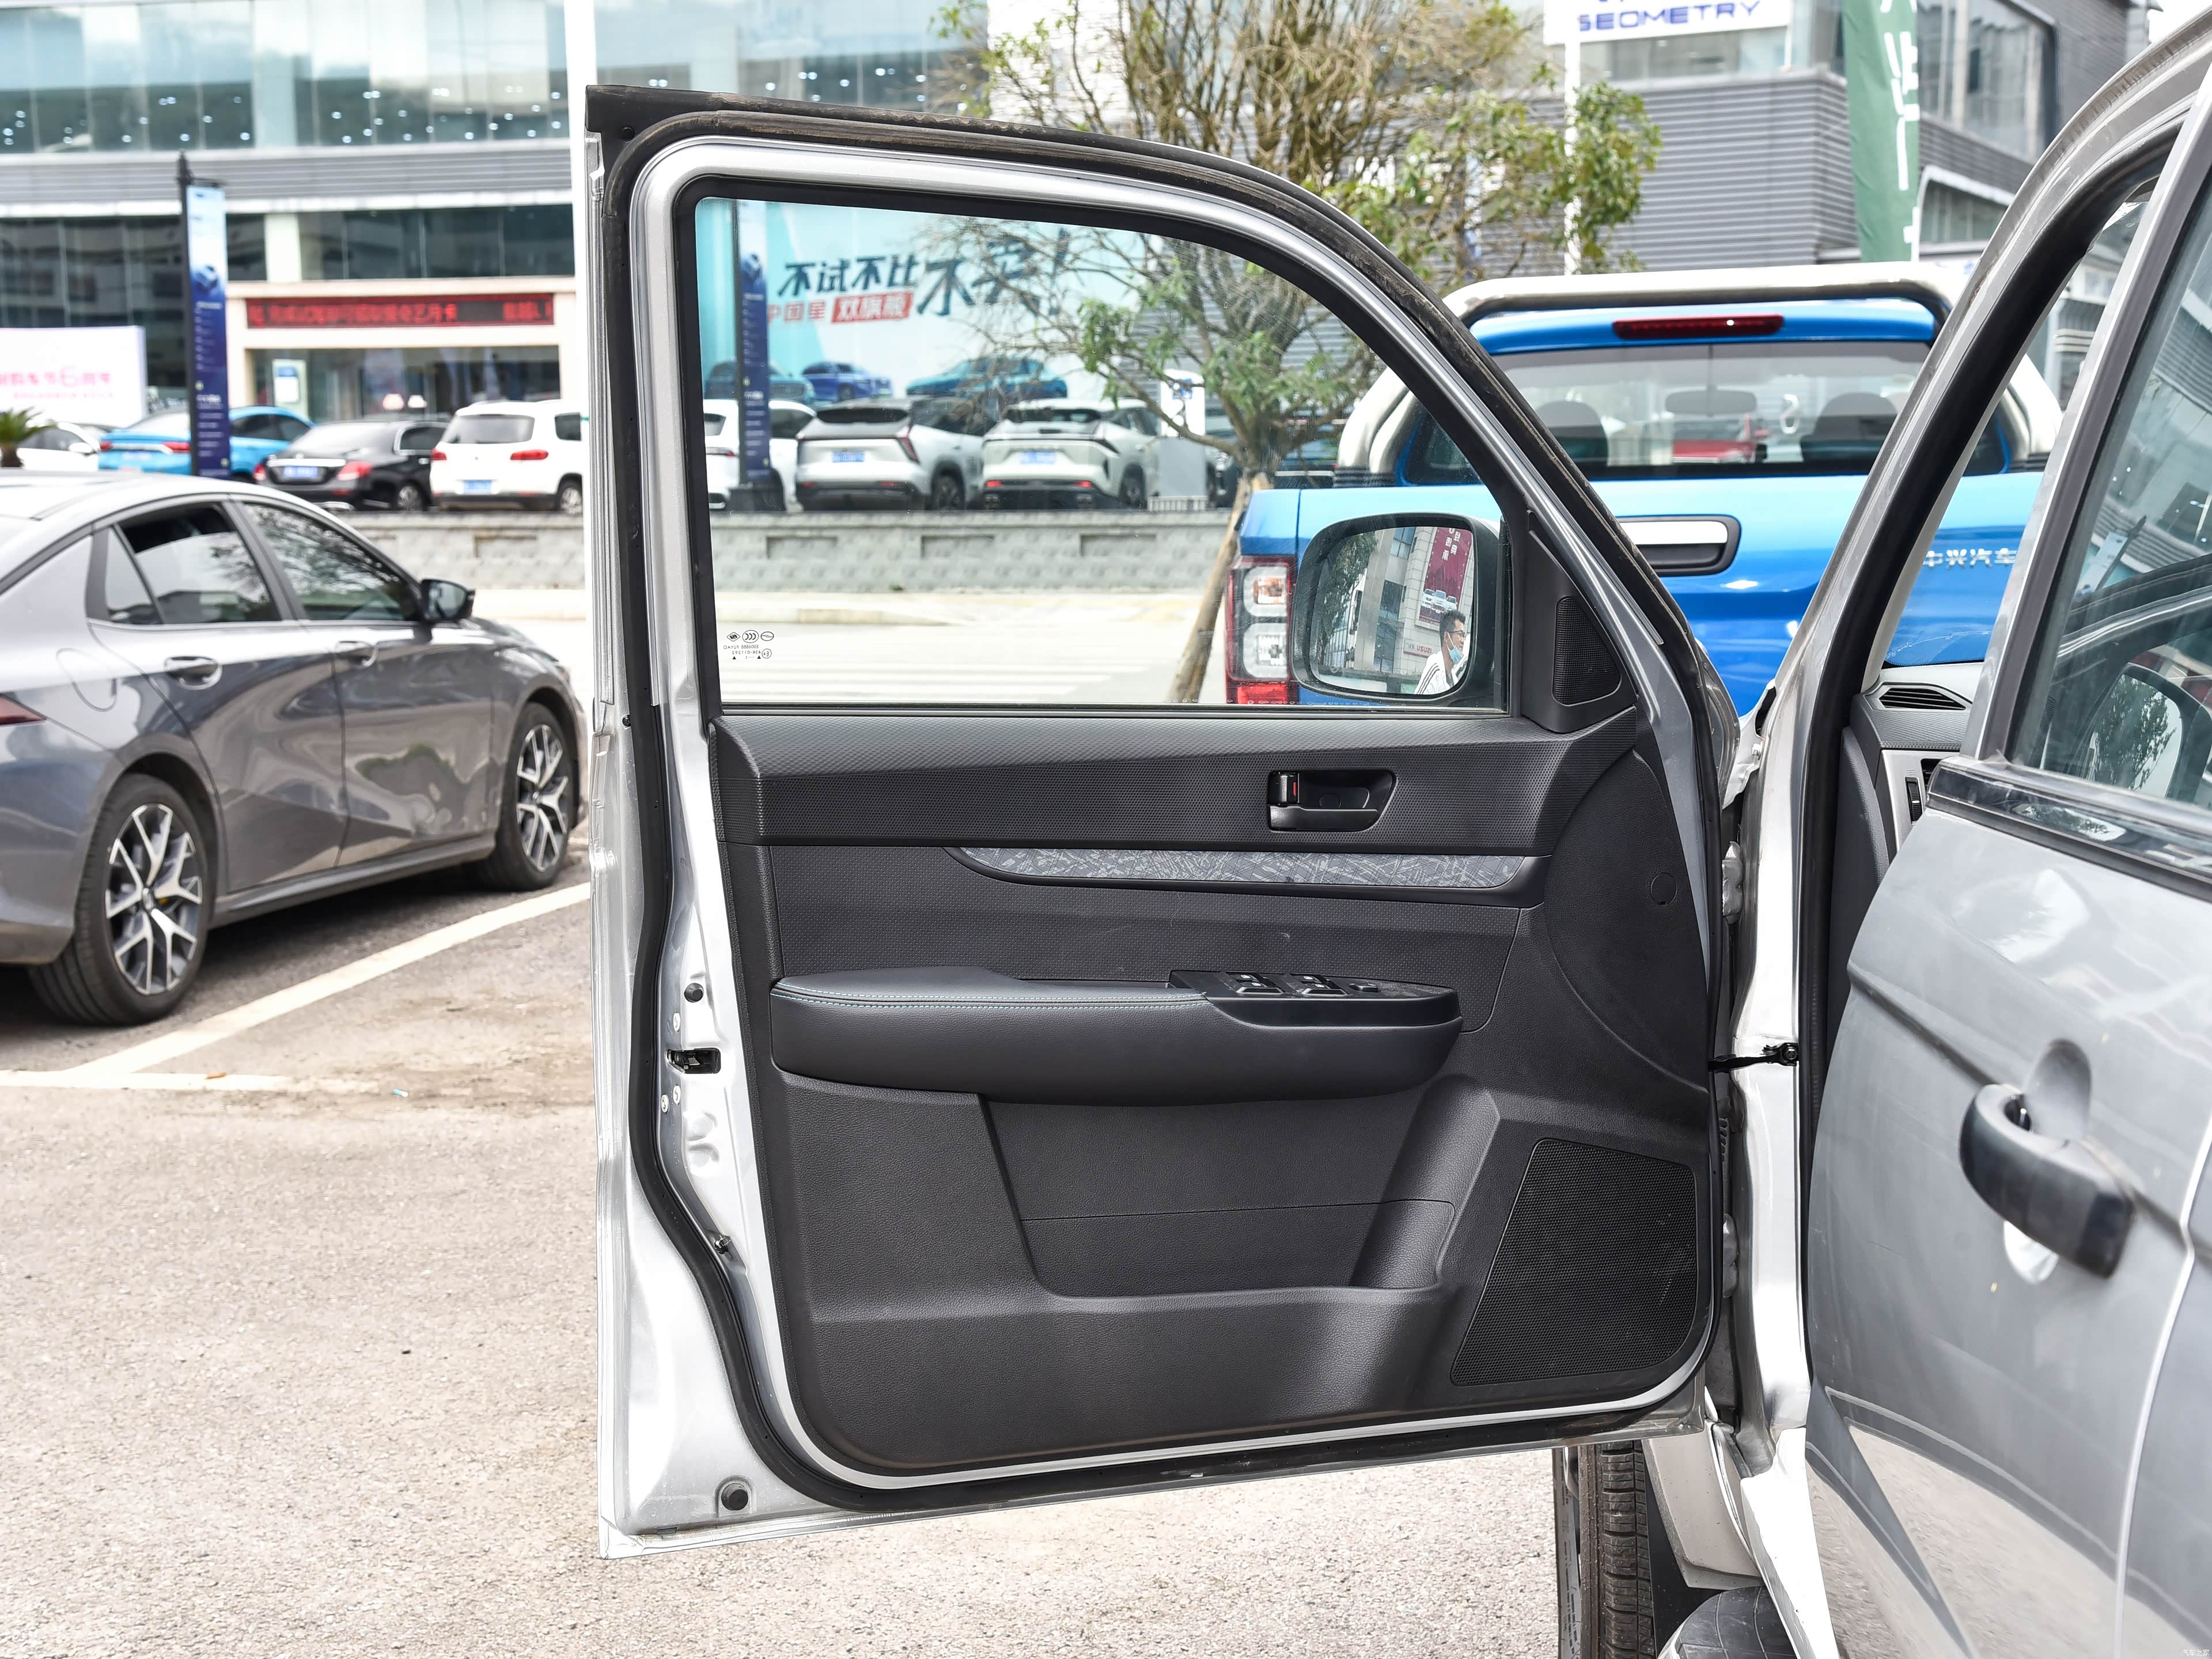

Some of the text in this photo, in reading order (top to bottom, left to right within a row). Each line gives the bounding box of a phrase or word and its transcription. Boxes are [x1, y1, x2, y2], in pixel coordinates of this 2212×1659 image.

[778, 253, 919, 297] 不试不比
[1922, 548, 2017, 569] 中兴汽车
